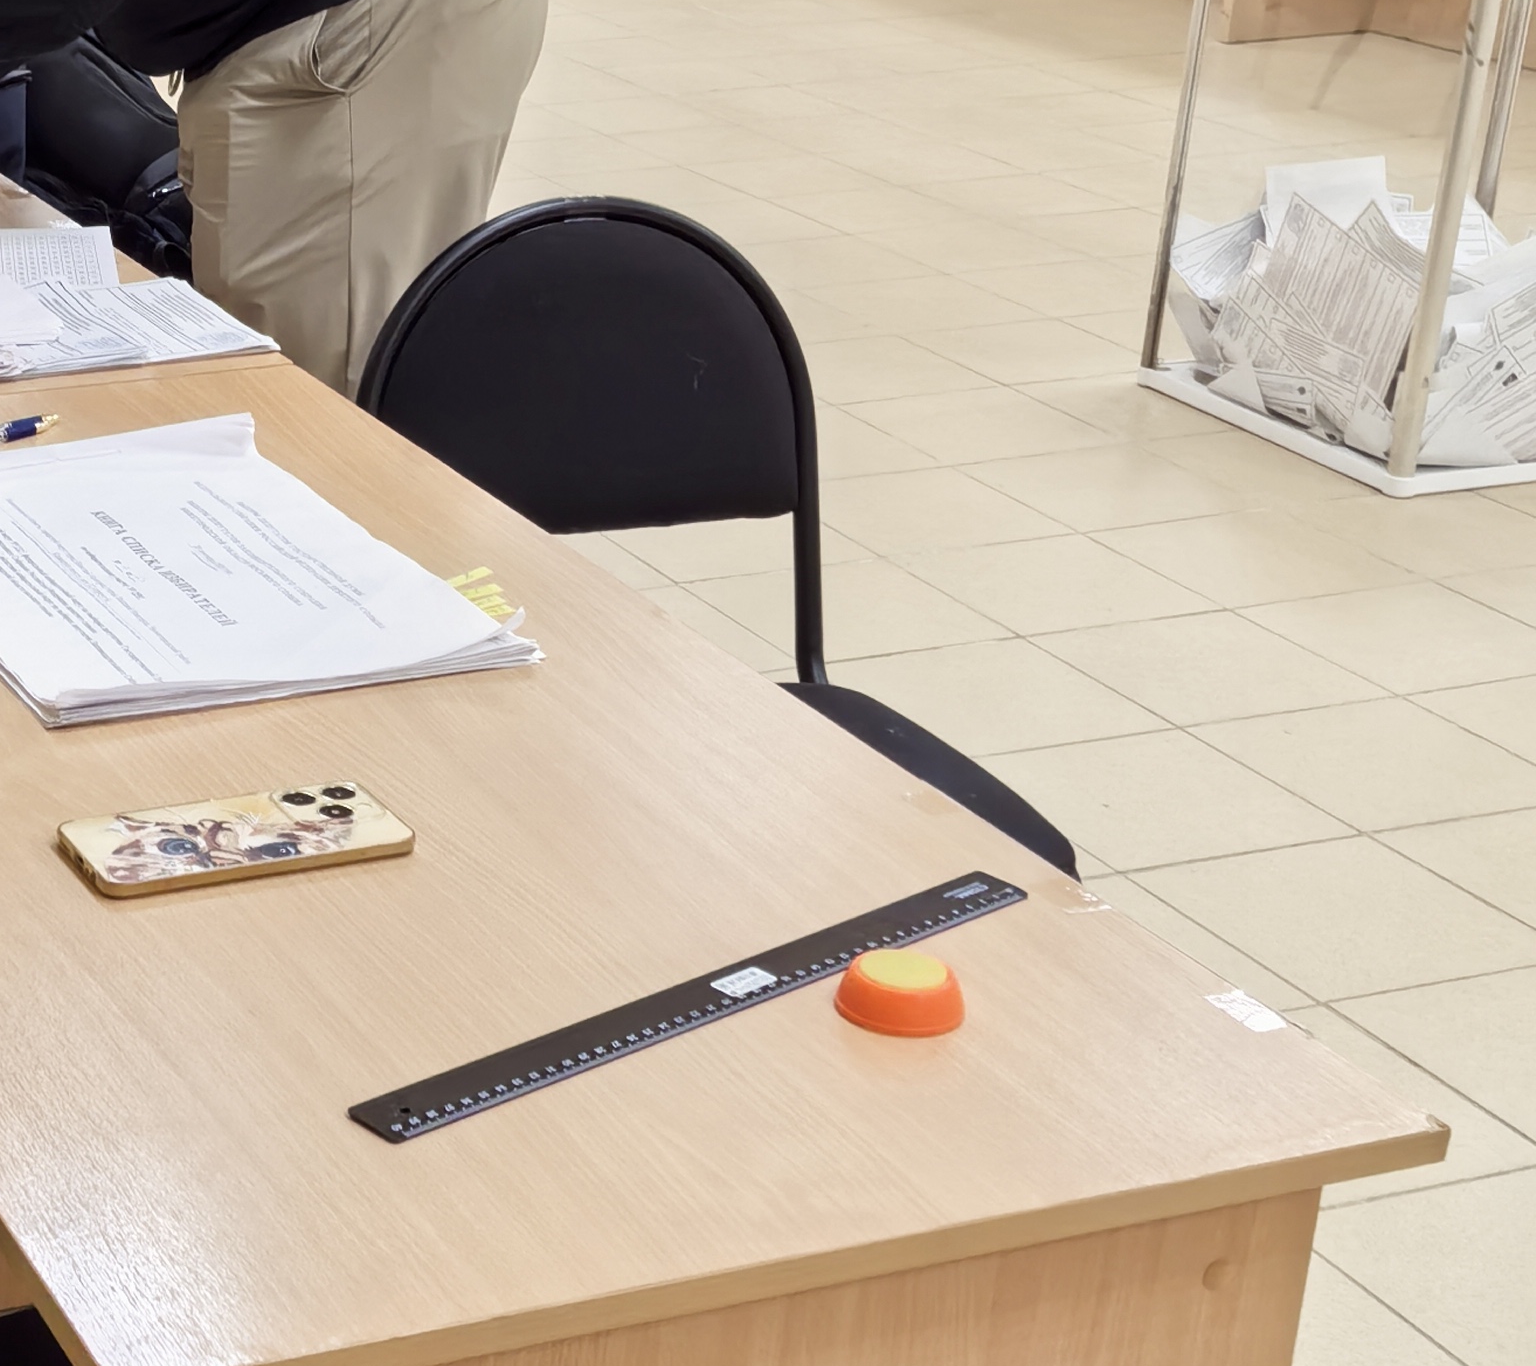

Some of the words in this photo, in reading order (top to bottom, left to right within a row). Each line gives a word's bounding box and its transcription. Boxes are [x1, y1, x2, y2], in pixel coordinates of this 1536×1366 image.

[89, 510, 128, 536] КНИГА
[120, 536, 165, 571] СПИСКА
[158, 569, 239, 627] ИЗБИРАТЕЛЕЙ
